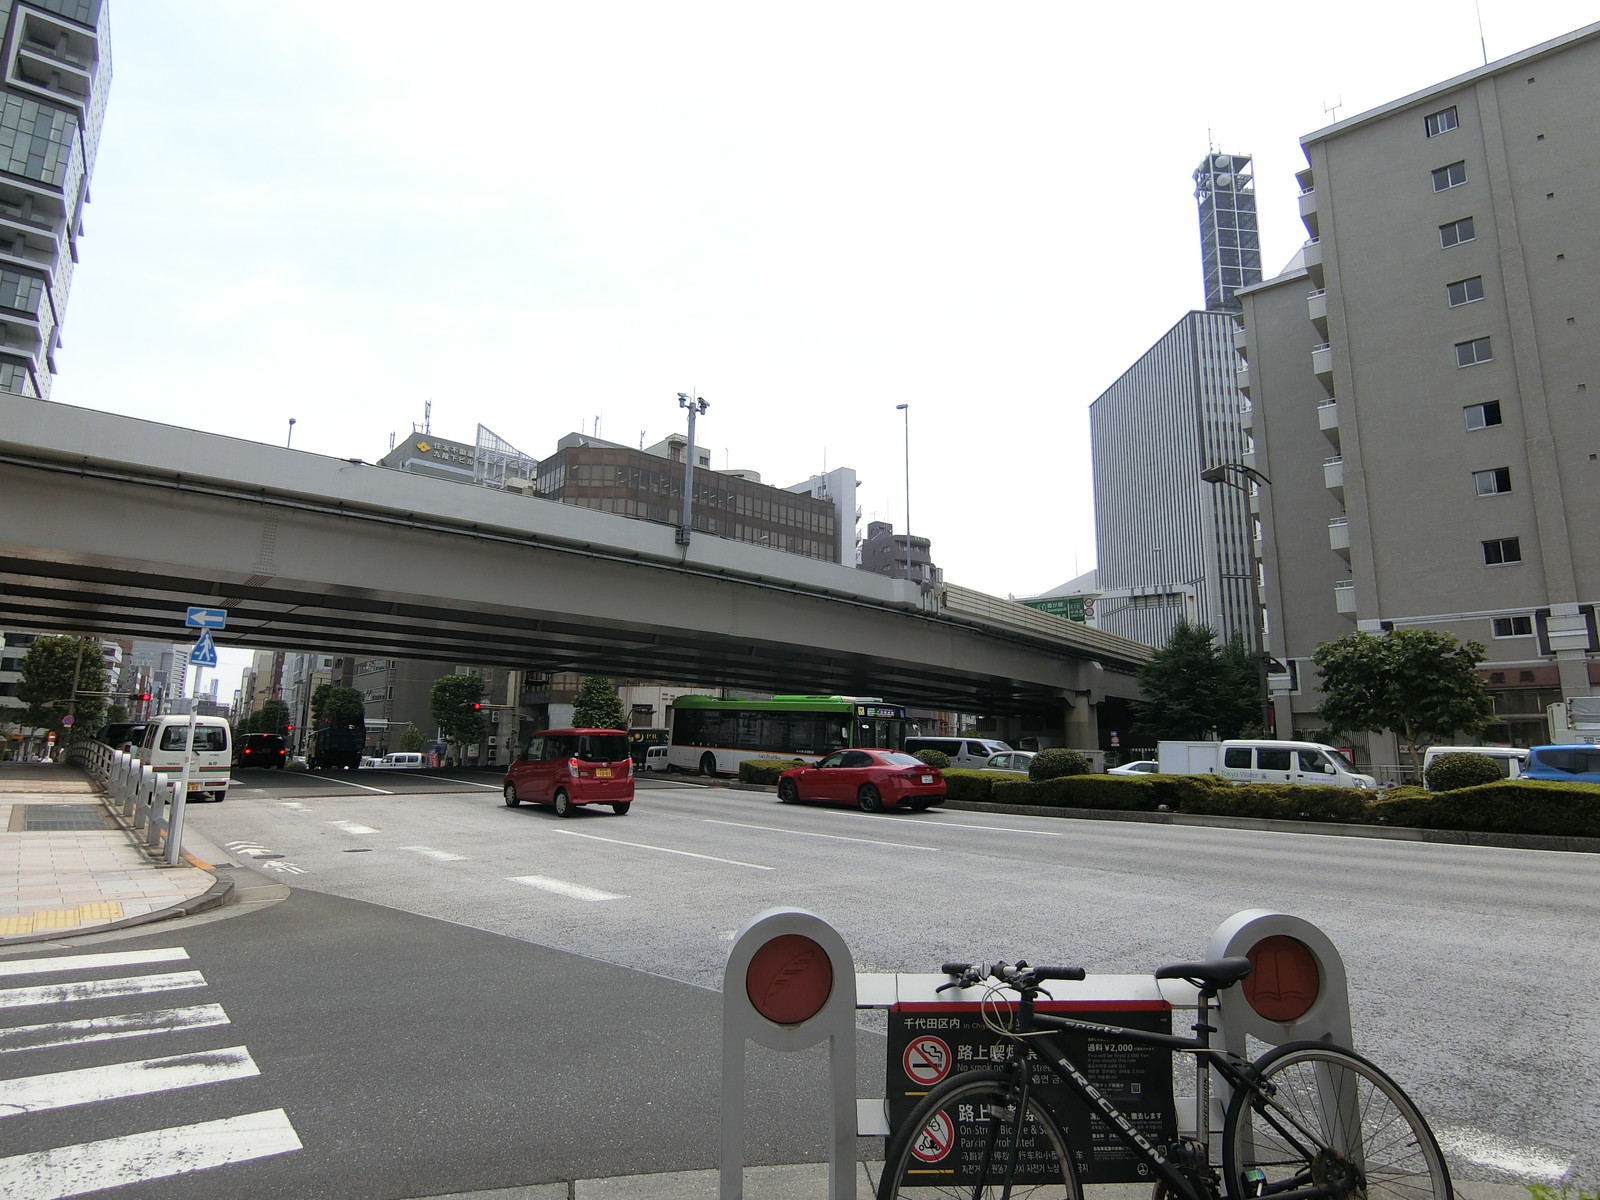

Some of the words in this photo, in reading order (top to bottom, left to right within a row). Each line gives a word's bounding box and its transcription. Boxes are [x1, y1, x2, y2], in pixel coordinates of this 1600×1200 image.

[433, 451, 474, 466] 九段下ビル
[1221, 770, 1239, 778] Tokyo
[1240, 771, 1258, 779] Water
[904, 1017, 960, 1030] 千代田区内
[1104, 1043, 1134, 1053] ¥2,000
[957, 1063, 969, 1071] No
[1058, 1058, 1165, 1164] PRECISION
[1030, 1125, 1037, 1134] &
